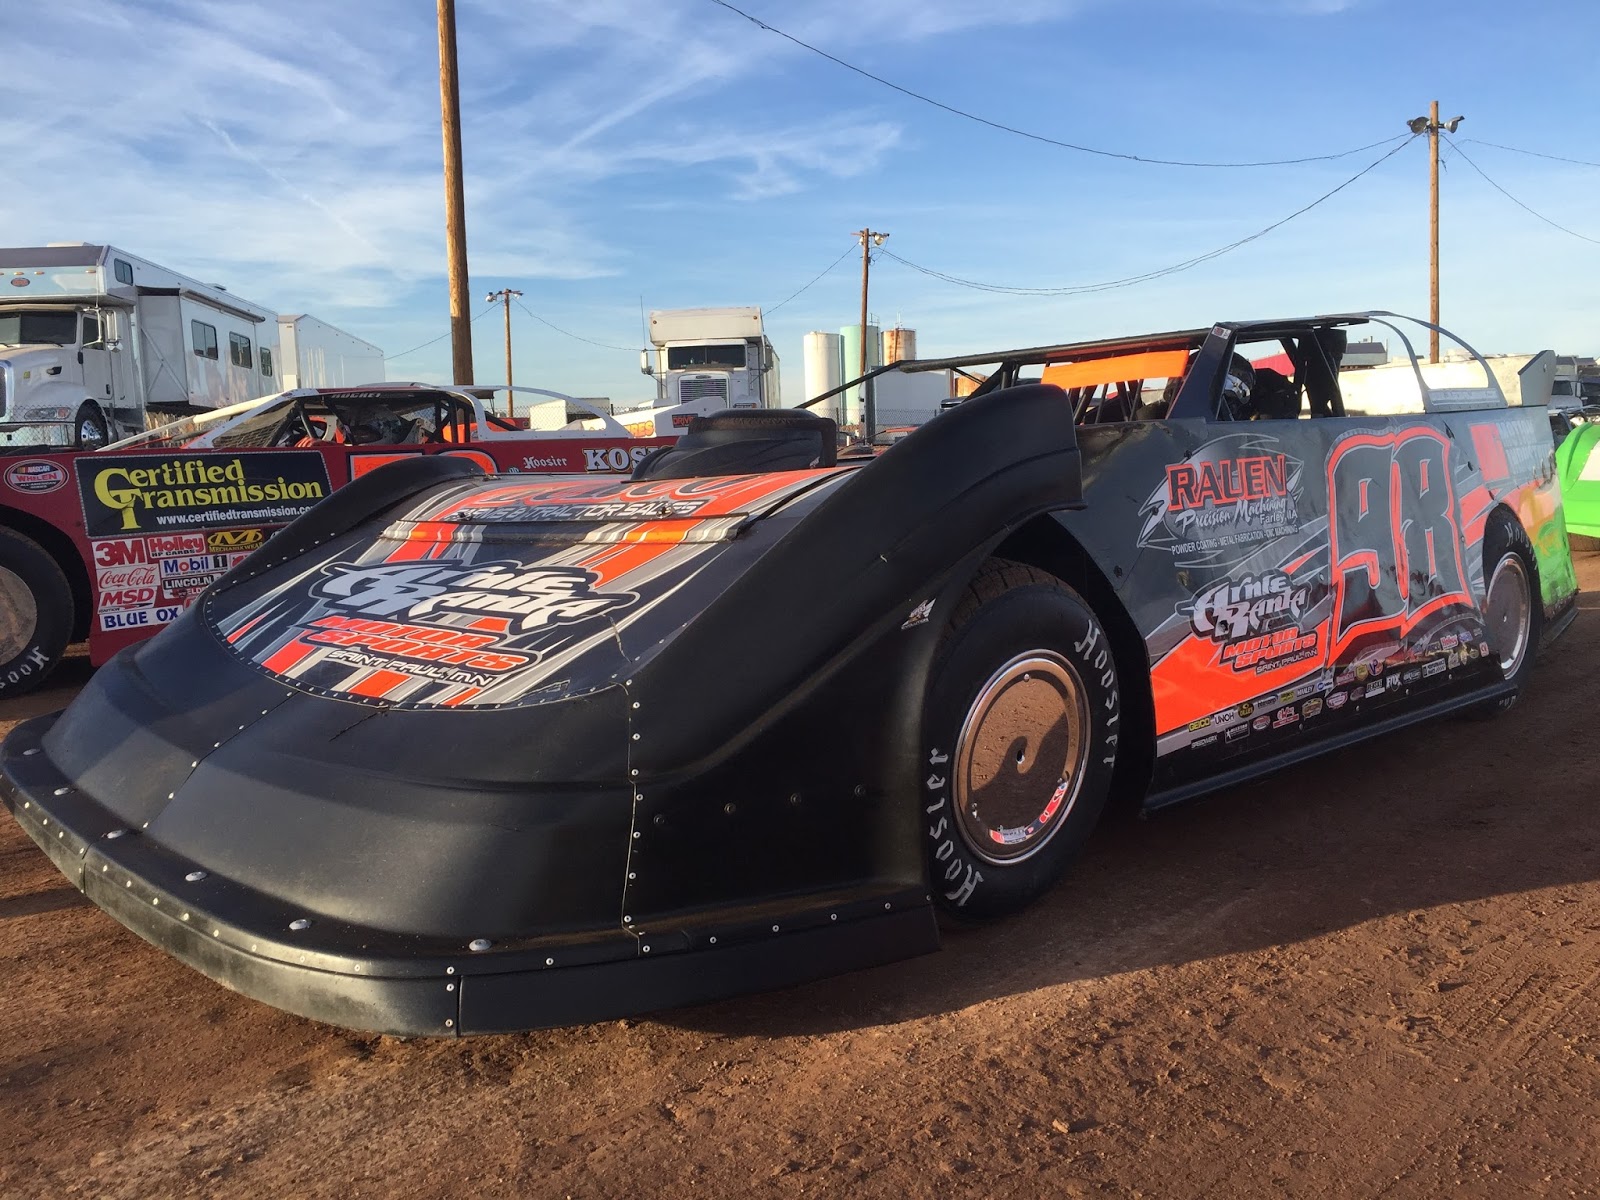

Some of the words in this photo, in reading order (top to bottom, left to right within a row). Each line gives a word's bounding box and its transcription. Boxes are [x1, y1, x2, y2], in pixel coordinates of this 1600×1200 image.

[27, 465, 51, 473] NASCAR
[522, 455, 568, 469] Hoosier
[583, 447, 662, 473] KOS
[16, 473, 57, 482] WHELEN
[94, 459, 246, 509] Certified
[1166, 453, 1288, 511] RAUEN
[108, 477, 324, 530] Transmission
[156, 504, 314, 525] www.certifiedtransmission.co
[530, 502, 624, 519] TRACTOR
[1175, 508, 1231, 534] Precision
[1233, 496, 1287, 522] Machining
[96, 540, 146, 567] 3M
[150, 536, 205, 552] Holley
[1171, 541, 1197, 555] POWDER
[1196, 539, 1218, 550] COATING
[1220, 536, 1236, 547] METAL
[1235, 531, 1264, 544] FABRICATION
[1328, 430, 1472, 660] 98
[164, 556, 209, 573] Mobil
[100, 566, 158, 589] Coca-Cola
[165, 574, 213, 589] LINCOLN
[102, 588, 155, 606] MSD
[104, 611, 148, 629] BLUE
[156, 607, 180, 621] OX
[312, 615, 502, 649] MOTOR
[1223, 627, 1298, 659] MOTOR
[307, 630, 530, 671] SPORTS
[1234, 634, 1317, 668] SPORTS
[329, 650, 386, 667] SAINT
[448, 672, 495, 687] MN
[1256, 660, 1281, 673] SAINT
[1189, 717, 1210, 731] GEICO
